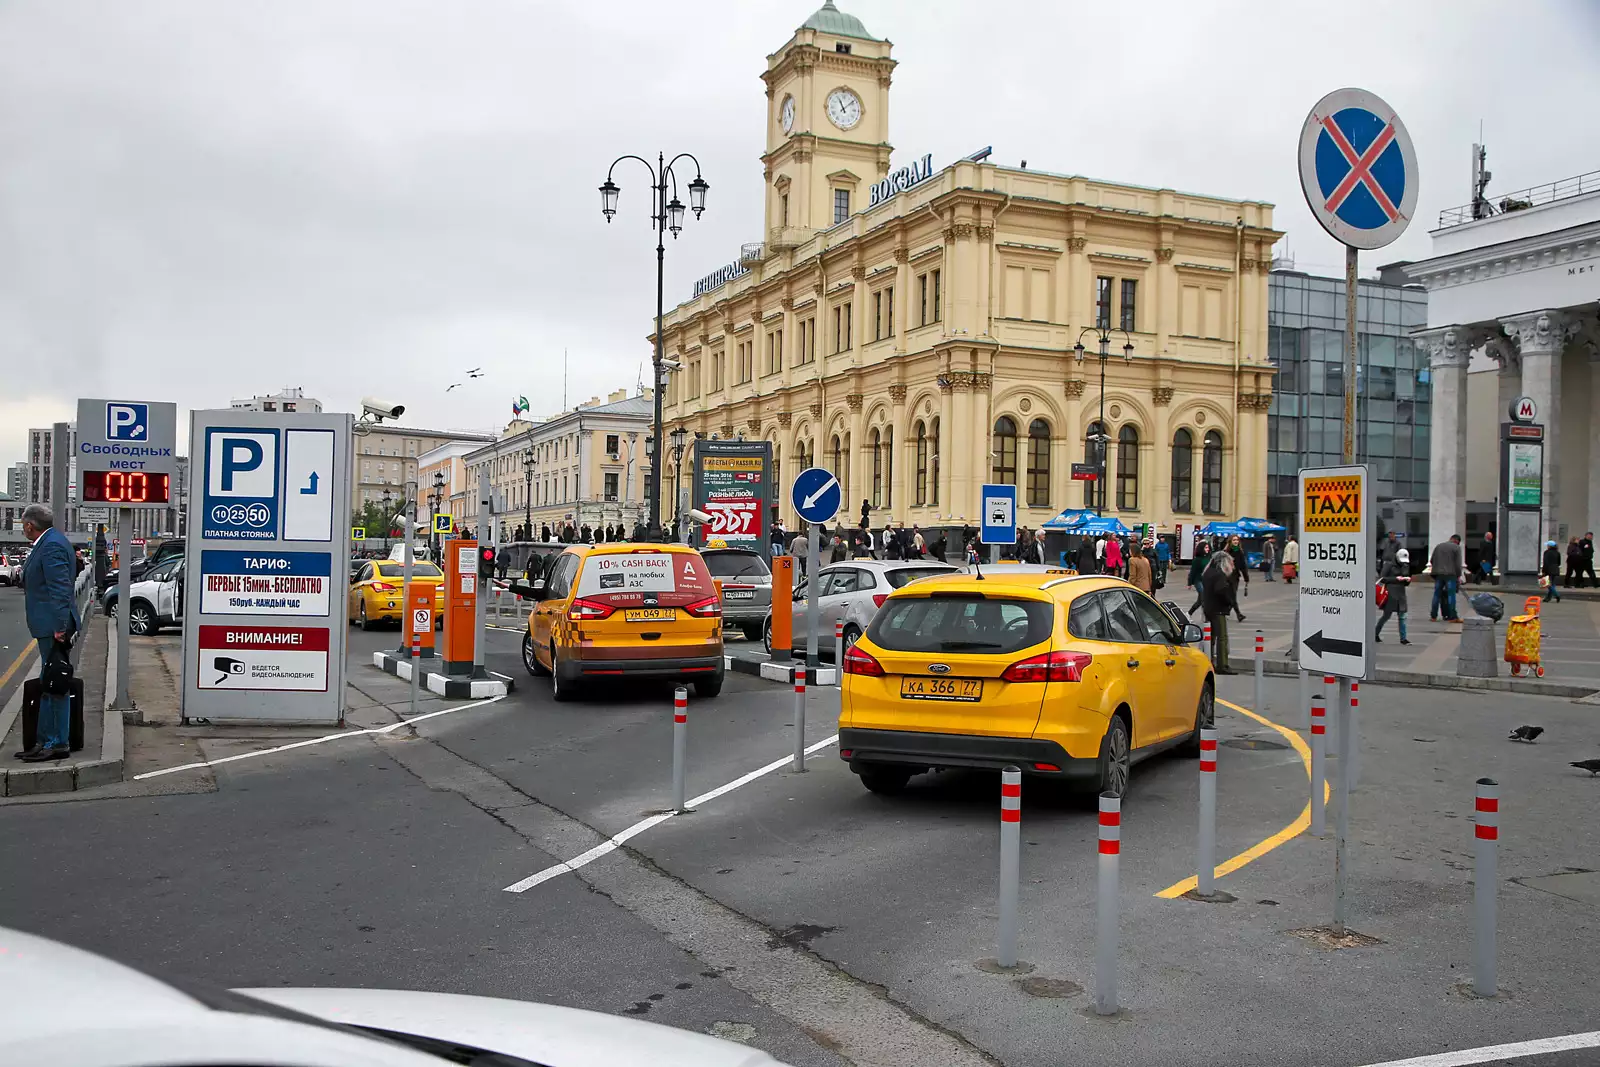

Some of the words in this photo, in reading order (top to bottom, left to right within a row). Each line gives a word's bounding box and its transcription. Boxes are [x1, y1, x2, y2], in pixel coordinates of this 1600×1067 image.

[869, 153, 932, 207] ВОКЗАЛ
[110, 405, 137, 437] P
[81, 442, 171, 458] Свободных
[109, 460, 146, 470] мест
[220, 437, 264, 492] P
[1306, 493, 1359, 514] TAXI
[215, 510, 227, 519] 10
[231, 509, 245, 520] 25
[248, 508, 267, 522] 50
[711, 511, 754, 533] DDT
[204, 529, 240, 538] ПЛАТНАЯ
[240, 530, 275, 539] СТОЯНКА
[1308, 543, 1357, 565] ВЪЕЗД
[243, 557, 291, 570] ТАРИФ:
[621, 559, 644, 568] CASH
[639, 571, 665, 579] любых
[1313, 569, 1337, 579] ТОЛЬКО
[1337, 571, 1351, 580] ДЛЯ
[207, 575, 242, 592] ПЕРВЫЕ
[629, 580, 644, 588] АЗС
[1301, 586, 1364, 599] ЛИЦЕНЗИРОВАННОГО
[287, 599, 301, 609] ЧАС
[1322, 605, 1341, 615] ТАКСИ
[643, 609, 660, 618] 049
[226, 631, 303, 645] ВНИМАНИЕ!
[908, 682, 924, 692] КА
[930, 680, 955, 694] 366
[963, 681, 977, 691] 77
